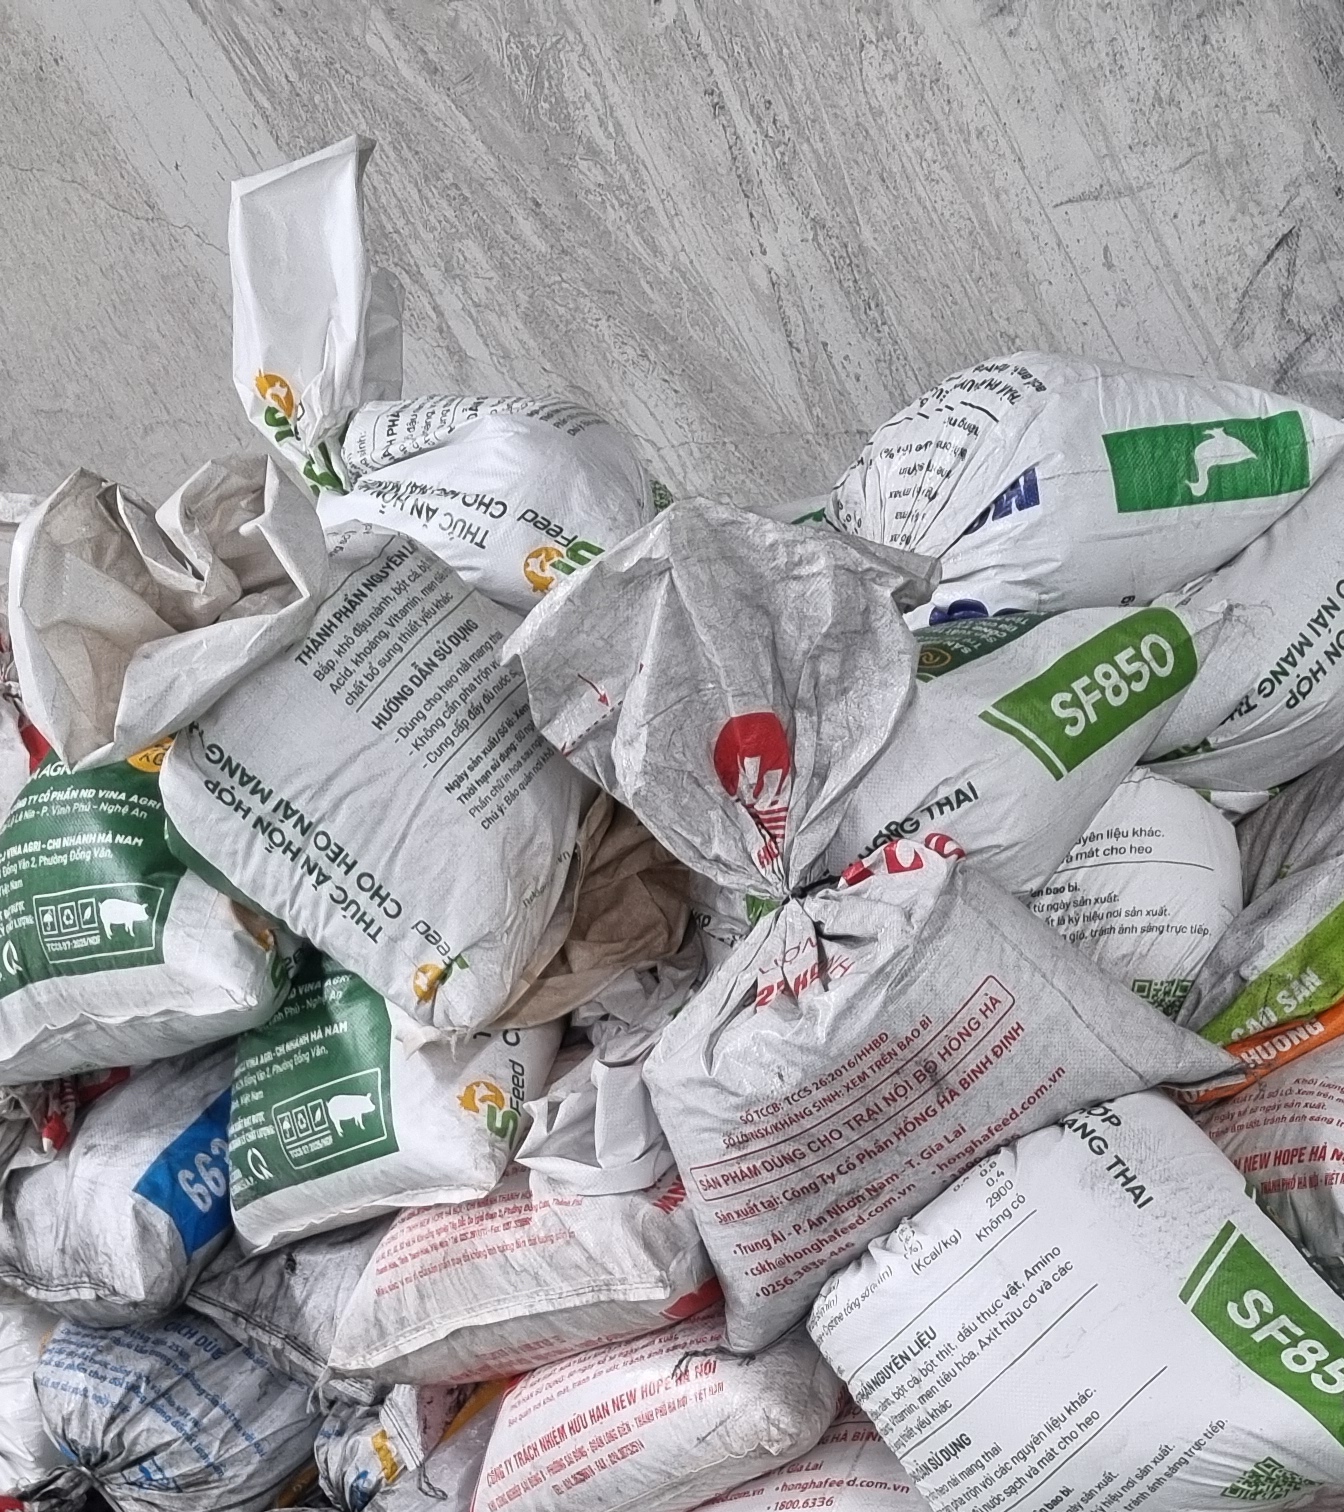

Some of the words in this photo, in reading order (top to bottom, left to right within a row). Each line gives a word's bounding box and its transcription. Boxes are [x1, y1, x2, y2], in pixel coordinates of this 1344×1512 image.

[292, 617, 341, 668] THÀNH
[329, 584, 371, 627] PHẦN
[1305, 595, 1344, 640] NÁI
[340, 677, 370, 708] chất
[360, 663, 382, 685] bổ
[375, 642, 405, 672] sung
[395, 618, 424, 648] thiết
[368, 680, 418, 732] HƯỚNG
[402, 650, 441, 690] DẪN
[429, 637, 456, 664] SỬ
[447, 615, 480, 649] DỤNG
[1044, 626, 1184, 740] SF850
[1253, 627, 1317, 706] MANG
[1277, 655, 1330, 717] HỢP
[395, 707, 429, 741] Dùng
[420, 689, 444, 713] cho
[438, 673, 460, 695] heo
[453, 658, 473, 678] nái
[409, 713, 448, 754] Không
[438, 696, 463, 721] cần
[456, 680, 480, 705] pha
[470, 663, 495, 689] trộn
[97, 786, 126, 804] VINA
[128, 790, 162, 813] AGRI
[199, 737, 275, 808] MANG
[200, 768, 256, 822] HỢP
[920, 779, 980, 828] THAI
[244, 812, 303, 868] HỖN
[268, 795, 314, 839] NÁI
[294, 854, 332, 891] ĂN
[307, 827, 359, 876] HEO
[1075, 846, 1099, 860] mát
[1102, 845, 1125, 856] cho
[1130, 843, 1152, 854] heo
[322, 881, 389, 945] THỨC
[349, 866, 408, 922] CHO
[696, 1169, 722, 1195] SẢN
[718, 1152, 762, 1193] PHẨM
[758, 1135, 808, 1180] DÙNG
[804, 1122, 844, 1157] CHO
[840, 1098, 885, 1136] TRẠI
[878, 1074, 916, 1108] NỘI
[932, 1014, 984, 1062] HỒNG
[972, 988, 1003, 1019] HÀ
[780, 1172, 822, 1209] Công
[816, 1166, 840, 1190] Ty
[832, 1153, 858, 1178] Cổ
[853, 1130, 895, 1165] Phần
[887, 1098, 938, 1141] HỒNG
[931, 1081, 962, 1110] HÀ
[953, 1053, 997, 1092] BÌNH
[985, 1019, 1030, 1062] ĐỊNH
[1102, 1152, 1154, 1212] THAI
[909, 1227, 964, 1277] (Kcal/kg)
[984, 1178, 1016, 1209] 2900
[973, 1205, 1015, 1244] Không
[1009, 1192, 1028, 1211] có
[905, 1324, 941, 1359] LIỆU
[916, 1356, 939, 1379] bột
[932, 1337, 960, 1364] thịt,
[952, 1318, 980, 1345] dầu
[974, 1296, 1007, 1327] thực
[999, 1276, 1028, 1304] vật,
[1020, 1242, 1063, 1282] Amino
[934, 1365, 959, 1389] tiêu
[974, 1325, 1003, 1352] Axit
[996, 1304, 1024, 1332] hữu
[1018, 1290, 1039, 1311] cơ
[1033, 1277, 1053, 1297] và
[1048, 1257, 1075, 1283] các
[938, 1430, 976, 1466] DỤNG
[976, 1471, 997, 1491] với
[990, 1458, 1014, 1481] các
[1007, 1426, 1050, 1468] nguyên
[1041, 1408, 1069, 1435] liệu
[1061, 1381, 1098, 1417] khác.
[979, 1441, 1003, 1464] thai
[1000, 1472, 1030, 1501] sạch
[1022, 1462, 1041, 1481] và
[1033, 1443, 1060, 1470] mát
[1054, 1428, 1079, 1452] cho
[1074, 1407, 1102, 1434] heo
